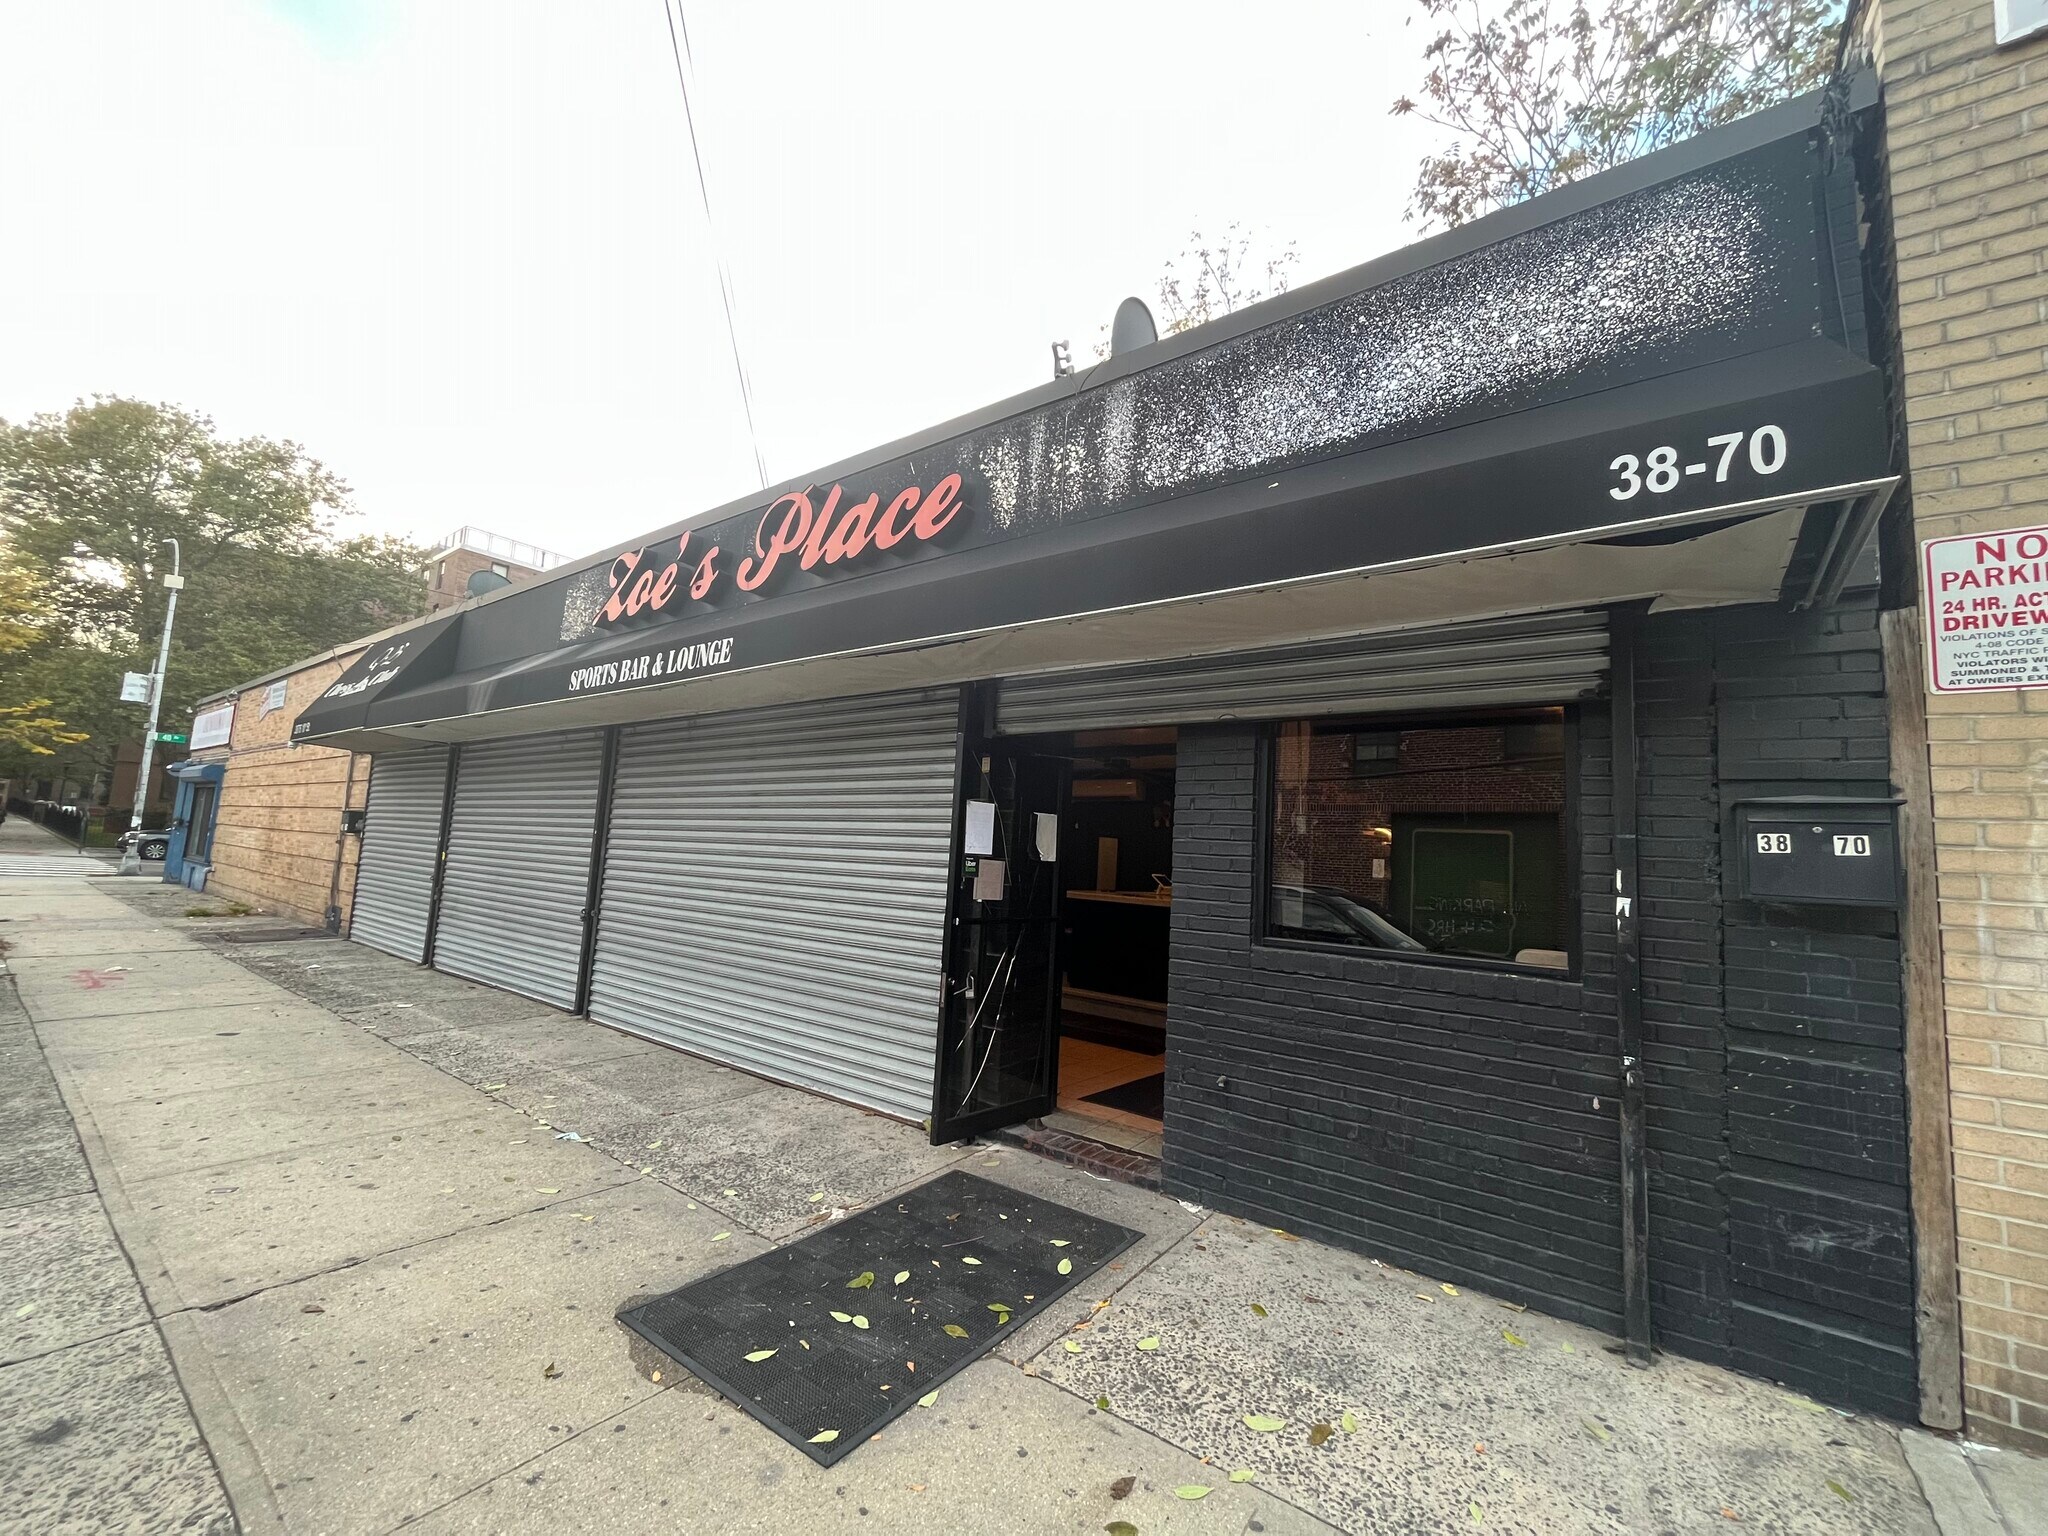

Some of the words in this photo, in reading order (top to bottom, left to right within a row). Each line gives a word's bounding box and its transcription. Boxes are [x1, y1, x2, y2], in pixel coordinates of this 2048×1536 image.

[1609, 424, 1787, 501] 38-70
[592, 530, 719, 627] Zoe's
[737, 473, 963, 591] Place
[1975, 534, 2048, 565] NO
[1941, 562, 2048, 592] PARKI
[1942, 599, 1965, 614] 24
[1972, 596, 2007, 611] HR.
[1940, 630, 2015, 642] VIOLATIONS
[2019, 628, 2037, 637] OF
[1975, 640, 2002, 649] 4-08
[2006, 637, 2045, 647] CODE
[1953, 651, 1980, 659] NYC
[1984, 647, 2041, 657] TRAFFIC
[568, 662, 618, 691] SPORTS
[619, 655, 650, 683] BAR
[651, 652, 664, 677] &
[666, 637, 734, 674] LOUNGE
[1951, 666, 2027, 677] SUMMONED
[1957, 658, 2028, 668] VIOLATORS
[1948, 678, 1963, 686] AT
[1967, 676, 2023, 685] OWNERS
[1760, 835, 1788, 852] 38
[1837, 836, 1867, 855] 70
